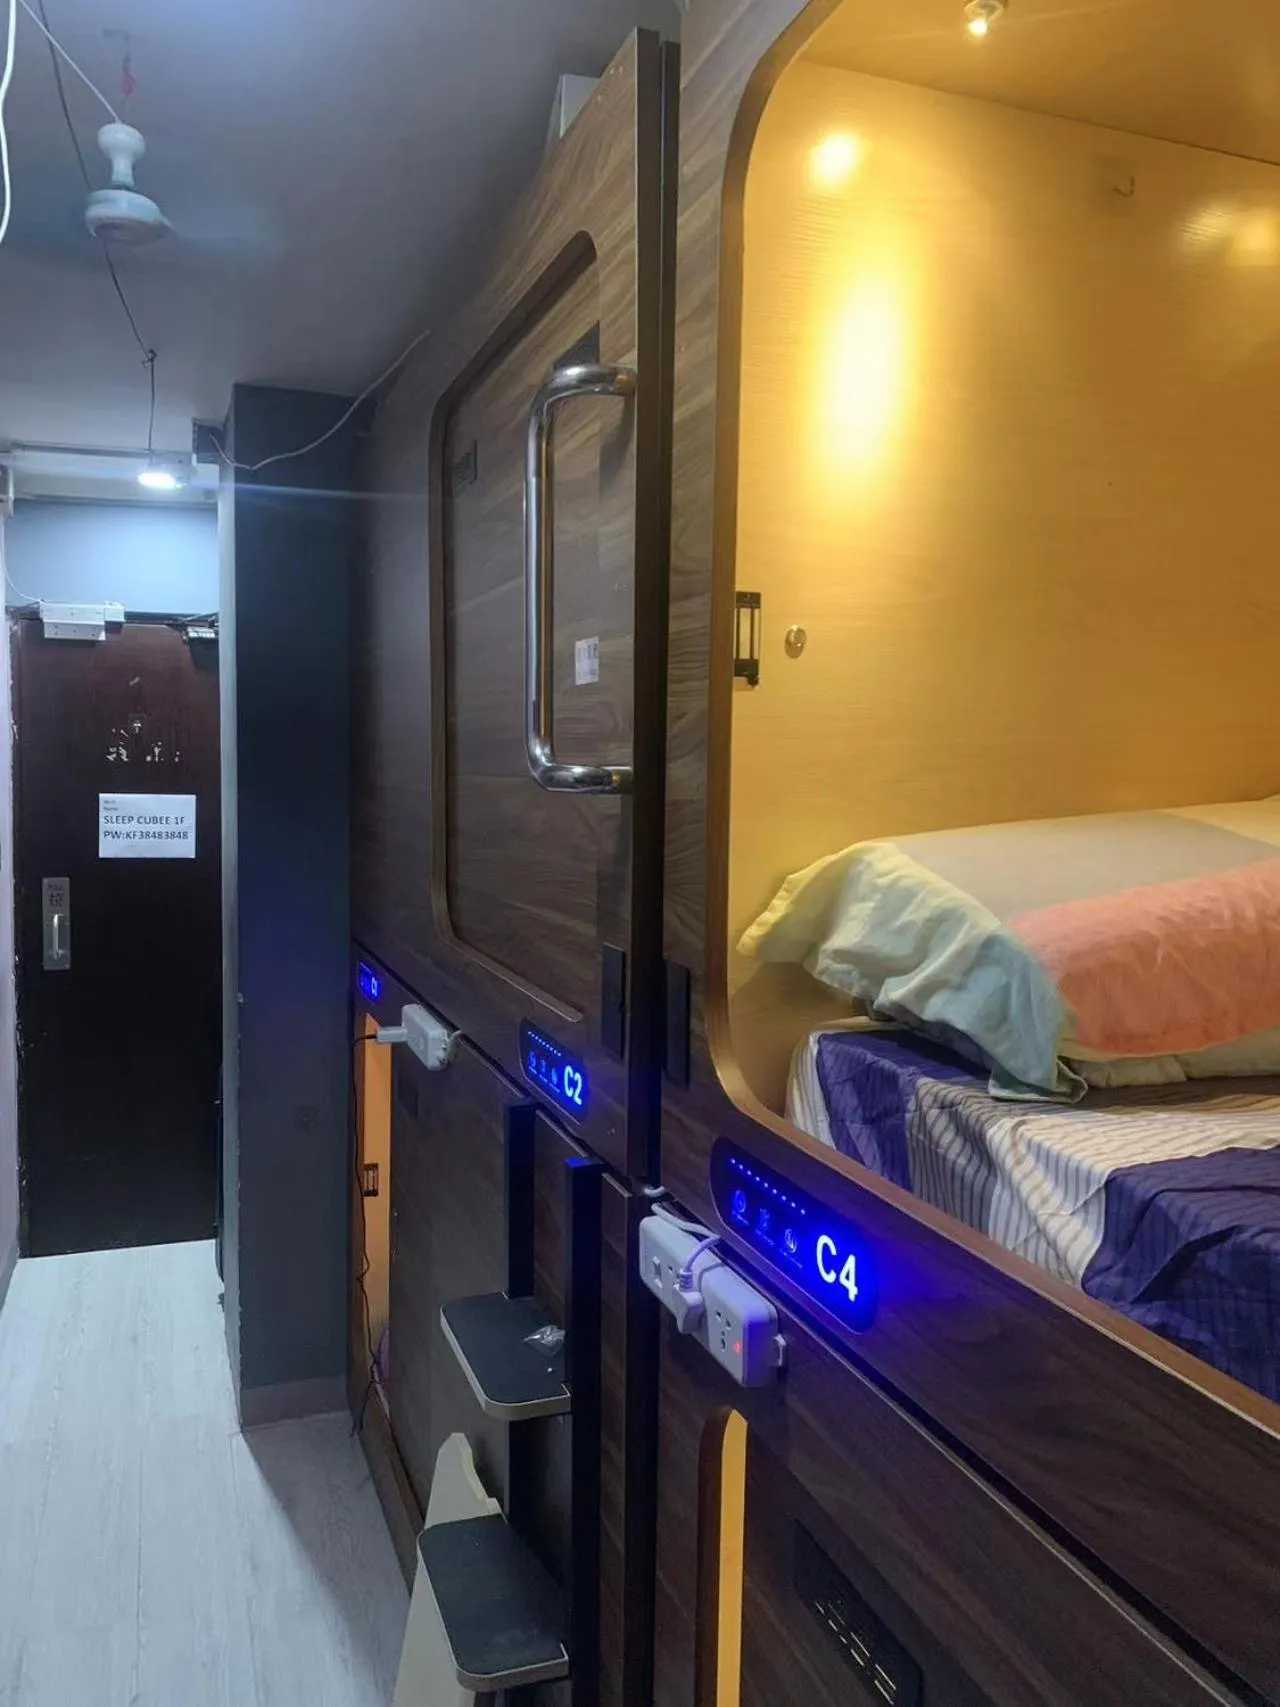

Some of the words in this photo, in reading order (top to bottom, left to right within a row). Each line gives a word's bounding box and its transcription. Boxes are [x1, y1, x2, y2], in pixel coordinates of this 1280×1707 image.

[104, 815, 134, 825] SLEEP
[136, 816, 170, 825] CUBEE
[174, 816, 185, 825] 1F
[564, 1065, 582, 1105] C2
[816, 1234, 858, 1302] C4
